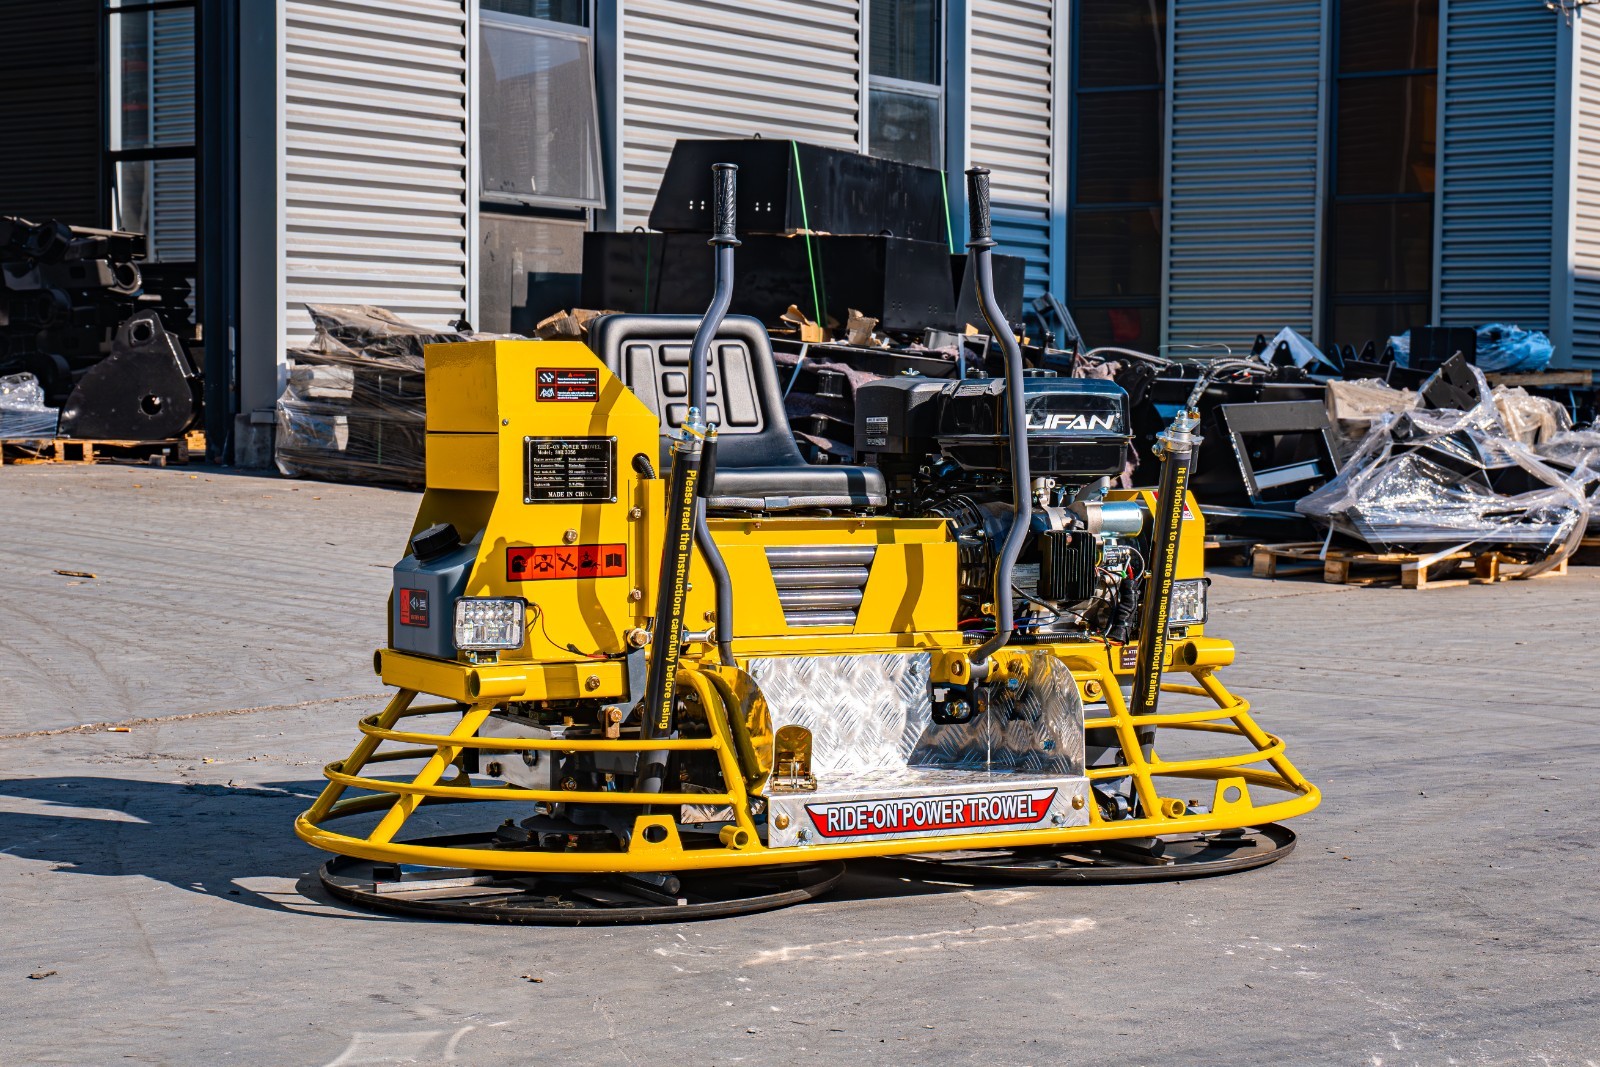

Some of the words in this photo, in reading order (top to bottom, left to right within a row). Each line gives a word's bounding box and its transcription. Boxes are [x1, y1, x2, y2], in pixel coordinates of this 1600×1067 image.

[1025, 413, 1115, 430] LIFAN
[683, 469, 697, 505] Please
[1176, 475, 1186, 485] is
[1177, 467, 1187, 475] It
[681, 506, 692, 531] read
[1170, 486, 1185, 530] forbidden
[679, 532, 690, 551] the
[1169, 530, 1178, 541] to
[1164, 542, 1176, 577] operate
[673, 553, 689, 616] instructions
[1161, 578, 1172, 595] the
[1156, 595, 1168, 634] machine
[665, 618, 679, 663] carefully
[1151, 634, 1164, 671] without
[663, 664, 676, 699] before
[1145, 671, 1159, 707] training
[658, 700, 671, 730] using
[826, 801, 898, 832] RIDE-ON
[902, 796, 965, 828] POWER
[967, 794, 1039, 822] TROWEL
